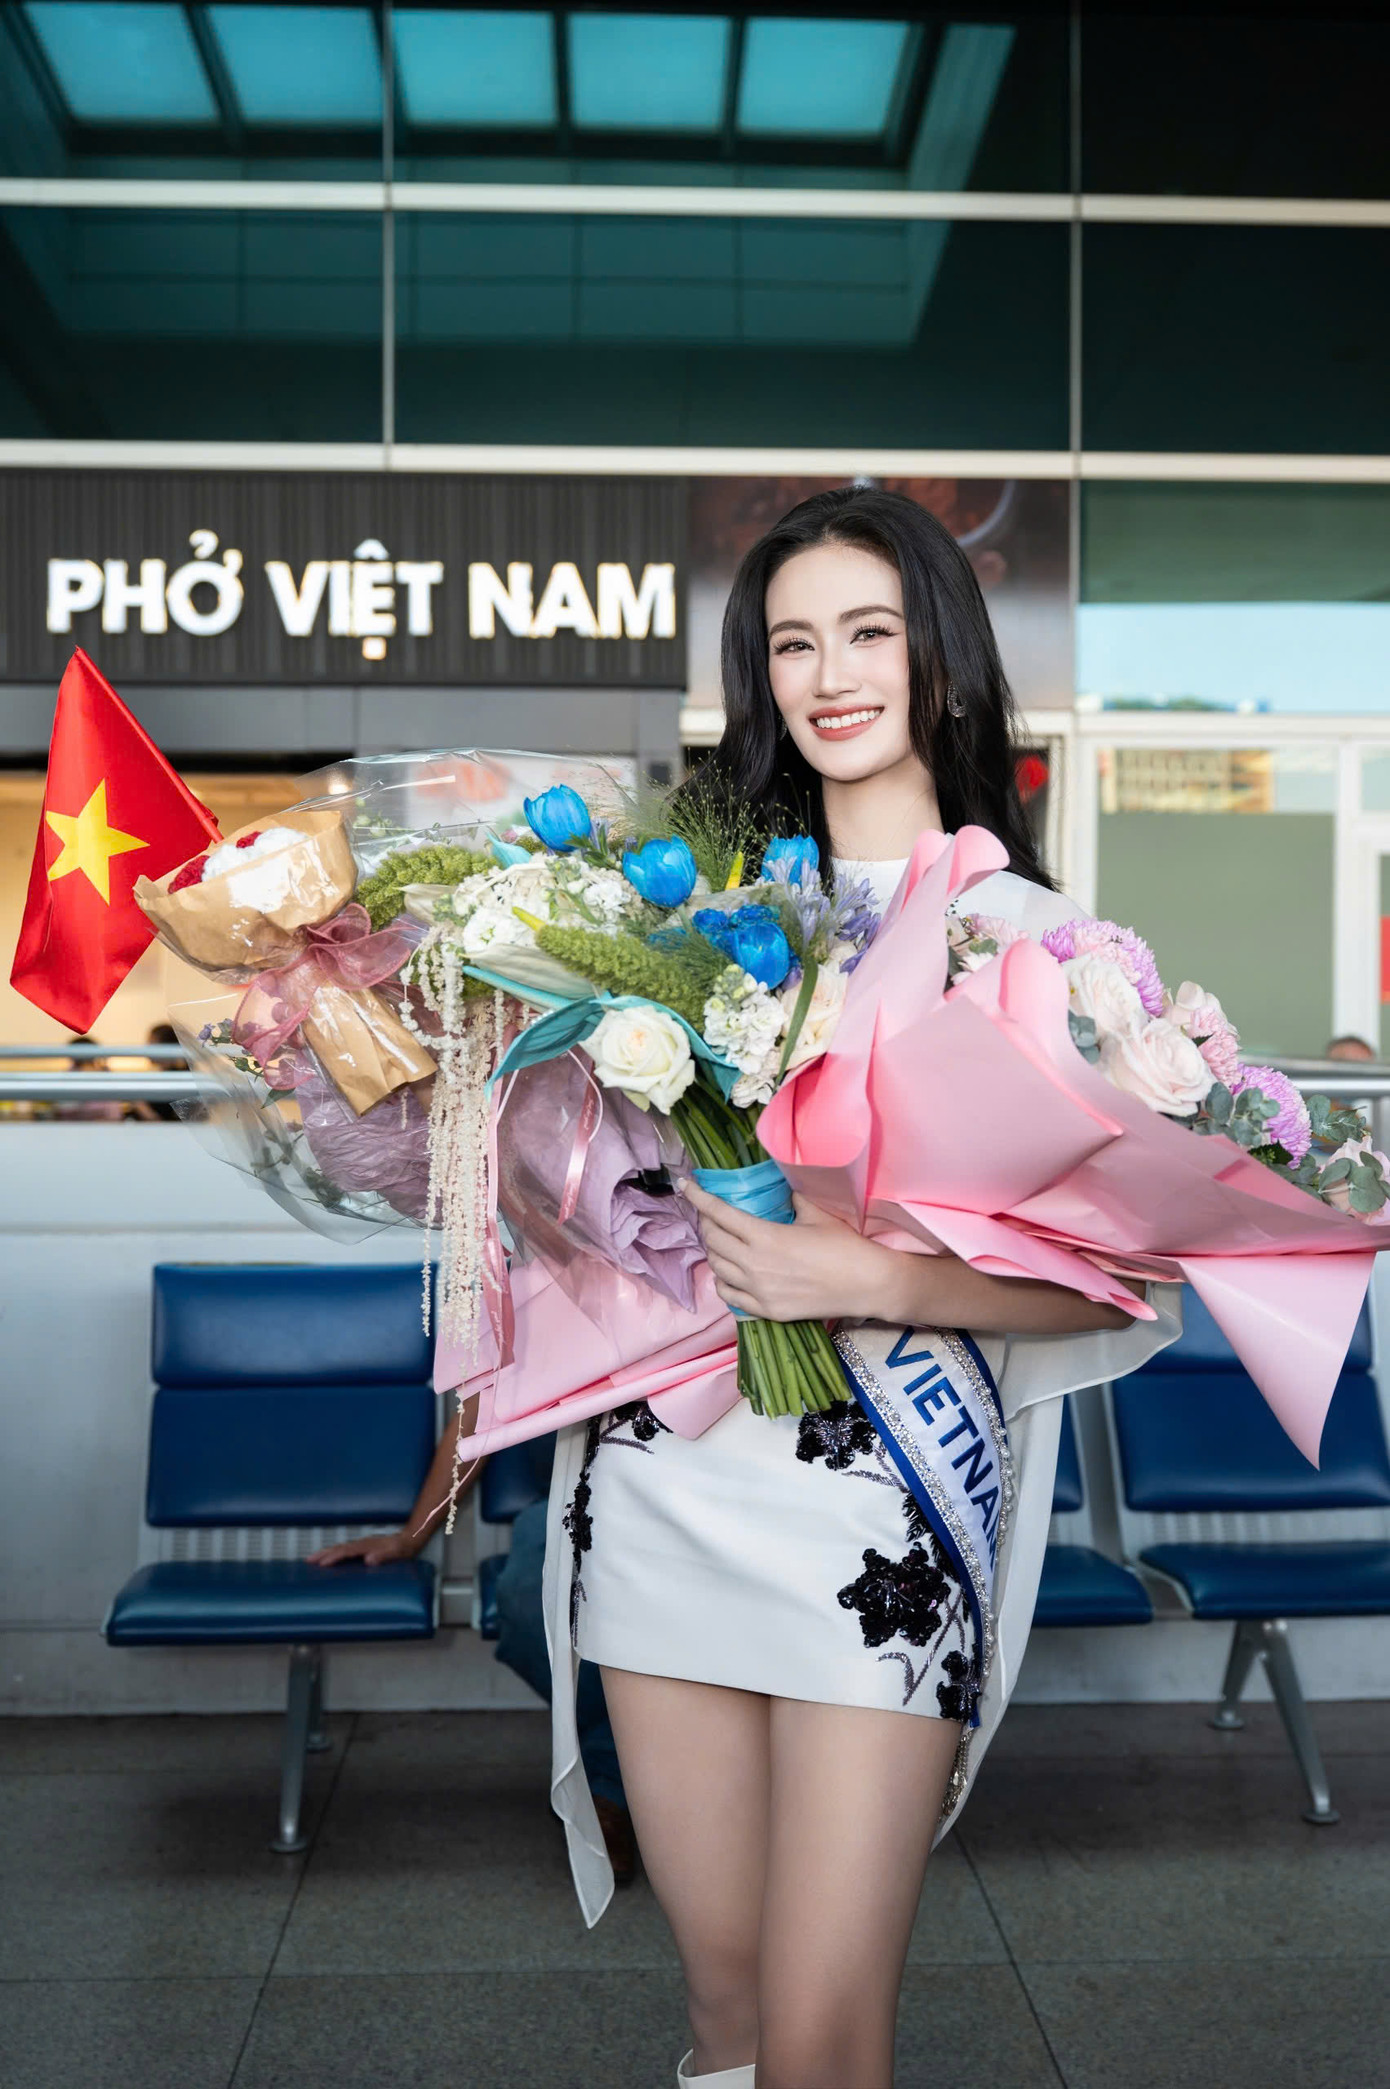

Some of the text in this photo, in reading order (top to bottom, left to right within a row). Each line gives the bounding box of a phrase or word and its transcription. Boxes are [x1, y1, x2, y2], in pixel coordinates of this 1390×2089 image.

[46, 529, 676, 661] PHỞ VIỆT NAM
